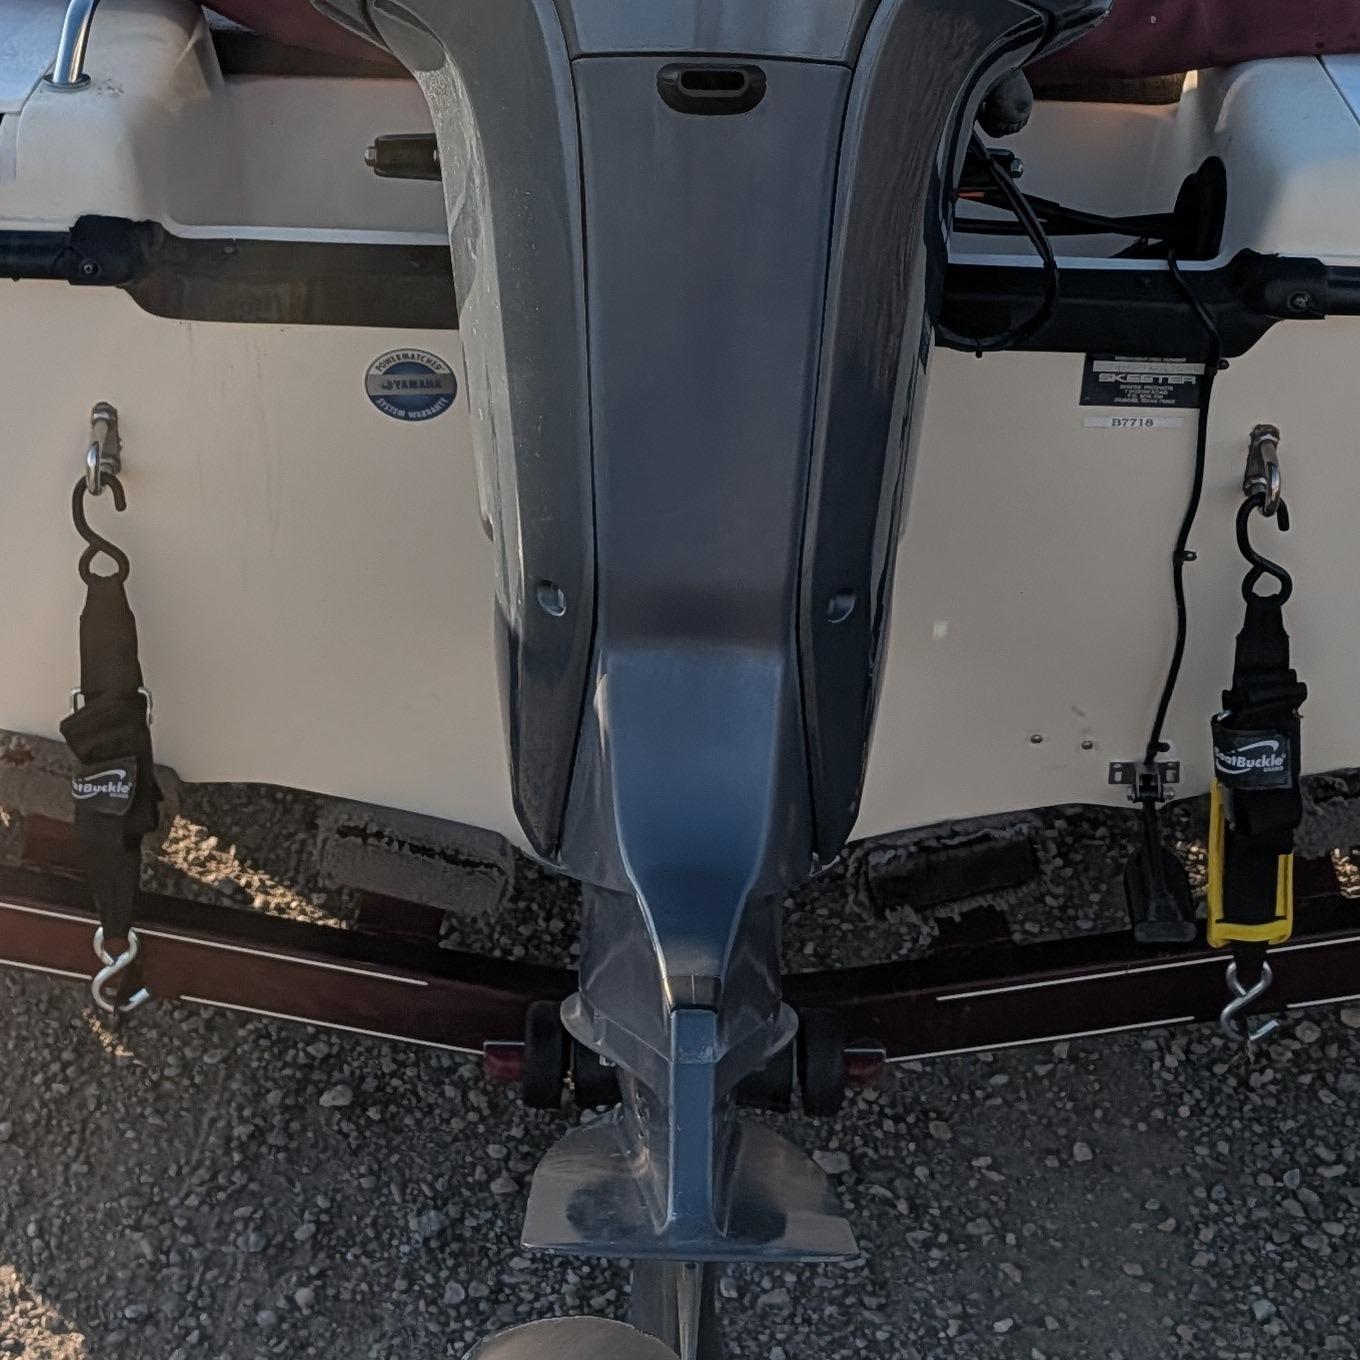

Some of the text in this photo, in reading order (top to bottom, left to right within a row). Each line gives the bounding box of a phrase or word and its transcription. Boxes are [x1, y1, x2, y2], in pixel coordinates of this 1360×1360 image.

[375, 352, 442, 372] POWERMATCHED
[394, 379, 442, 390] YAMAHA
[1098, 372, 1197, 385] SKEETER
[376, 396, 449, 419] SYSTEM WARRANTY
[1111, 418, 1154, 428] B7718
